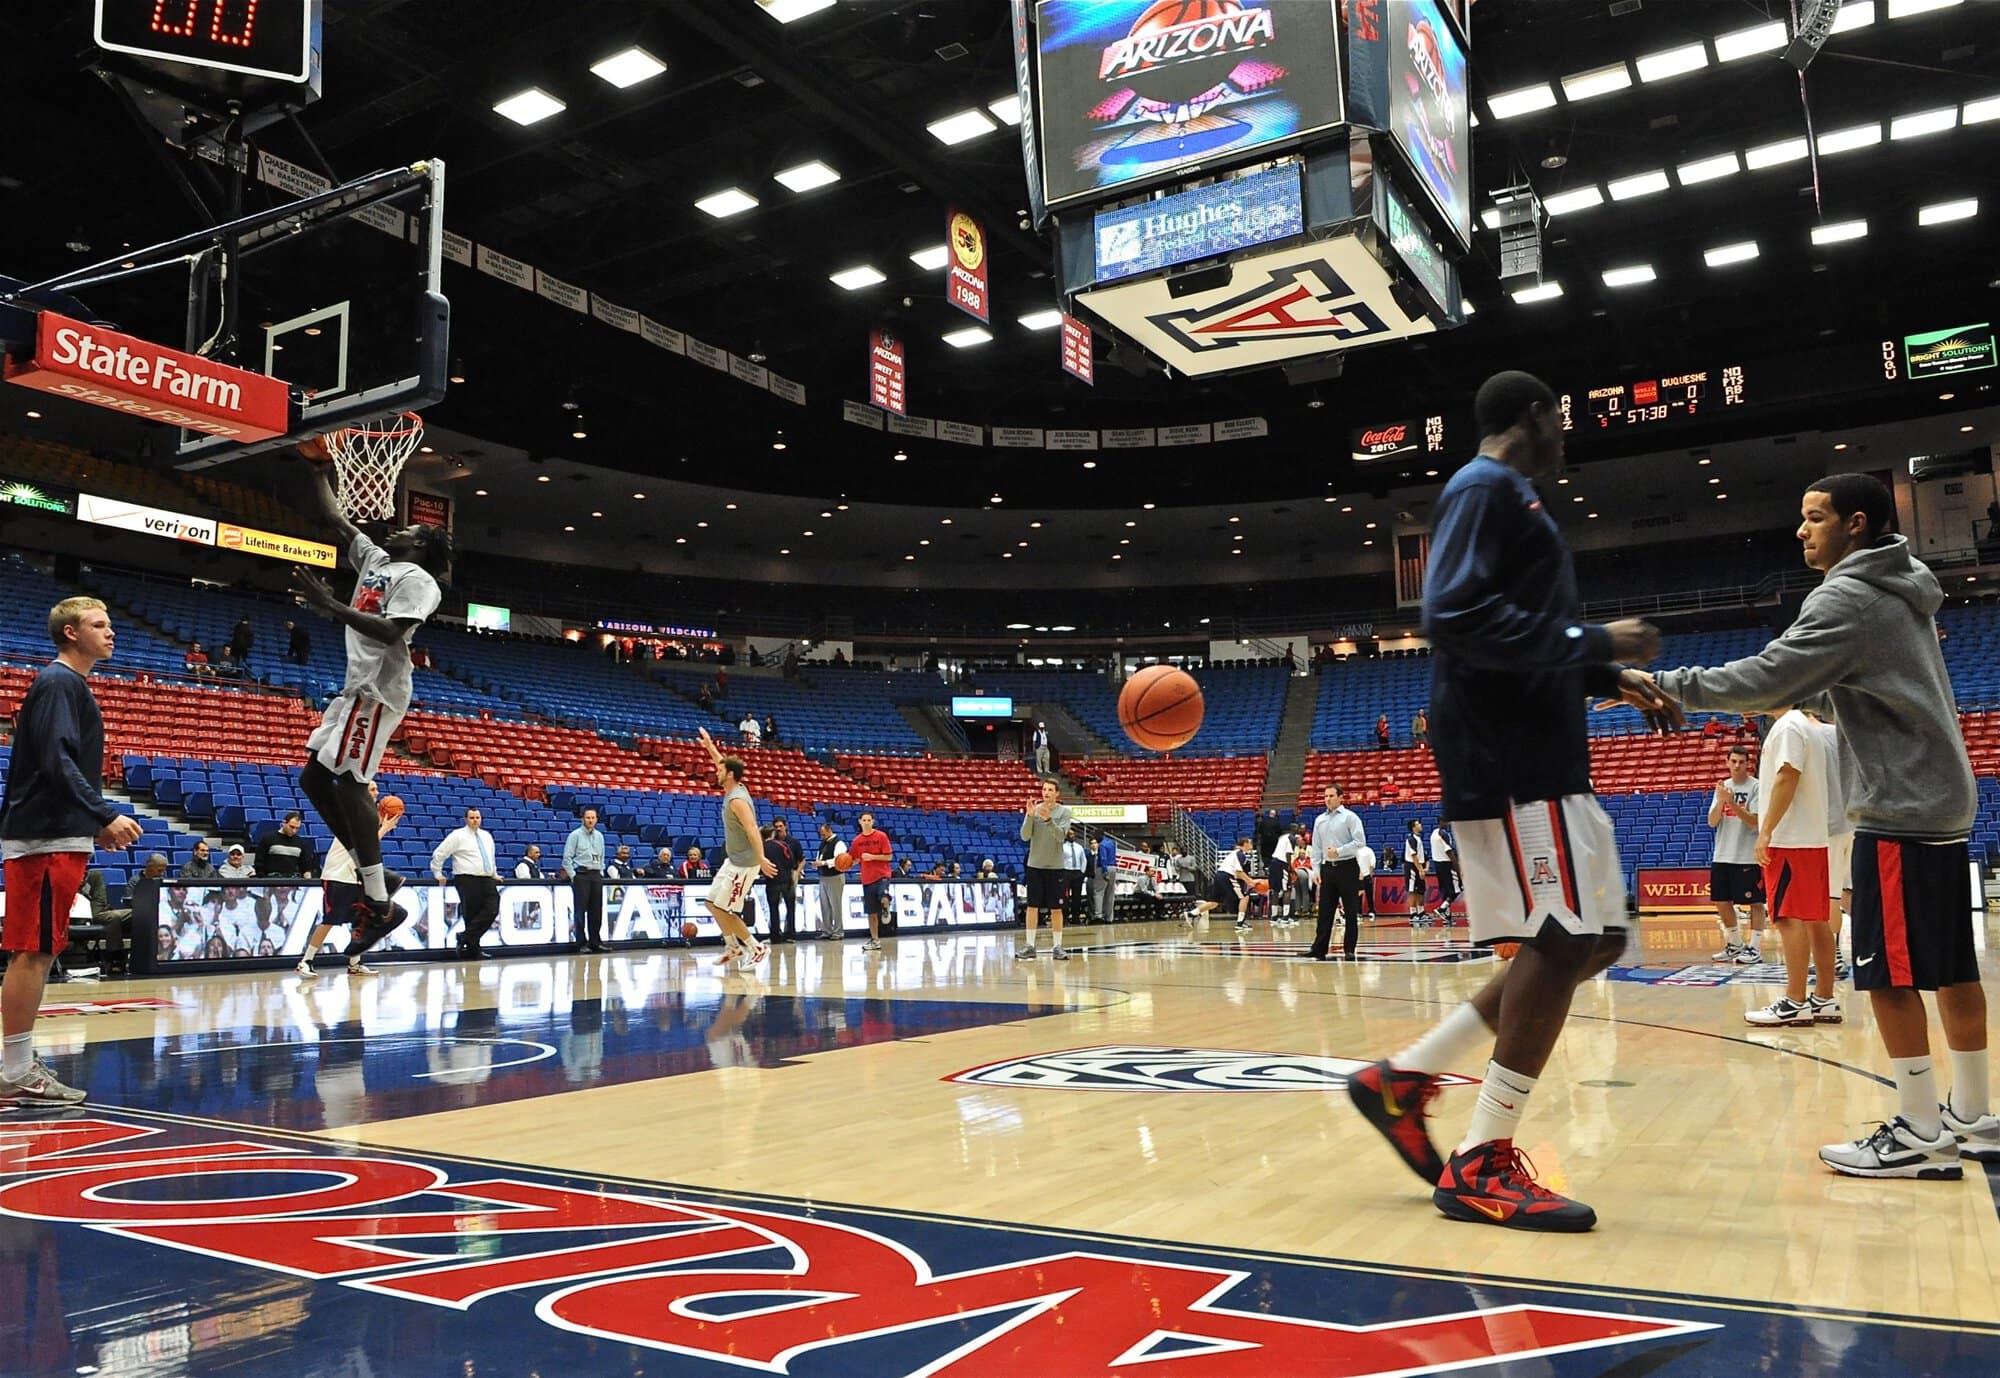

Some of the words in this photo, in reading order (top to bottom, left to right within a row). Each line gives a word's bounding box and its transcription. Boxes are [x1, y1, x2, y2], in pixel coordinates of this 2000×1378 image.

[1104, 12, 1272, 75] ARIZONA
[264, 155, 289, 173] CHASE
[291, 166, 326, 188] BUDINGER
[277, 171, 321, 194] BASKETBALL
[1144, 202, 1242, 238] Hughes
[951, 266, 985, 292] ARIZONA
[956, 285, 980, 310] 1988
[1065, 324, 1082, 338] SWEET
[873, 346, 902, 365] ARIZONA
[1910, 351, 1941, 363] BRIGHT
[1941, 344, 1990, 358] SOLUTIONS
[51, 328, 150, 385] State
[152, 355, 240, 411] Farm
[874, 362, 893, 375] SWEET
[1723, 366, 1741, 377] NO
[1661, 372, 1707, 387] DUQUESNE
[1723, 375, 1744, 387] PTS
[1589, 386, 1624, 399] ARIZONA
[1725, 385, 1743, 396] RB
[1726, 395, 1744, 405] FL
[48, 384, 151, 412] State
[150, 409, 241, 436] Farm
[1561, 395, 1573, 431] ARIZ
[1627, 405, 1667, 423] 57:38
[1425, 424, 1443, 435] PTS
[1426, 416, 1442, 427] NO
[1427, 433, 1442, 443] RB
[14, 495, 66, 513] SOLUTIONS
[414, 497, 444, 510] Pac-10
[144, 516, 211, 541] verizon
[245, 536, 280, 552] Lifetime
[283, 544, 312, 558] Brakes
[607, 622, 654, 633] ARIZONA
[658, 627, 708, 638] WILDCATS
[349, 717, 369, 759] CATS
[1530, 857, 1557, 885] A
[1644, 883, 1711, 897] WELLS
